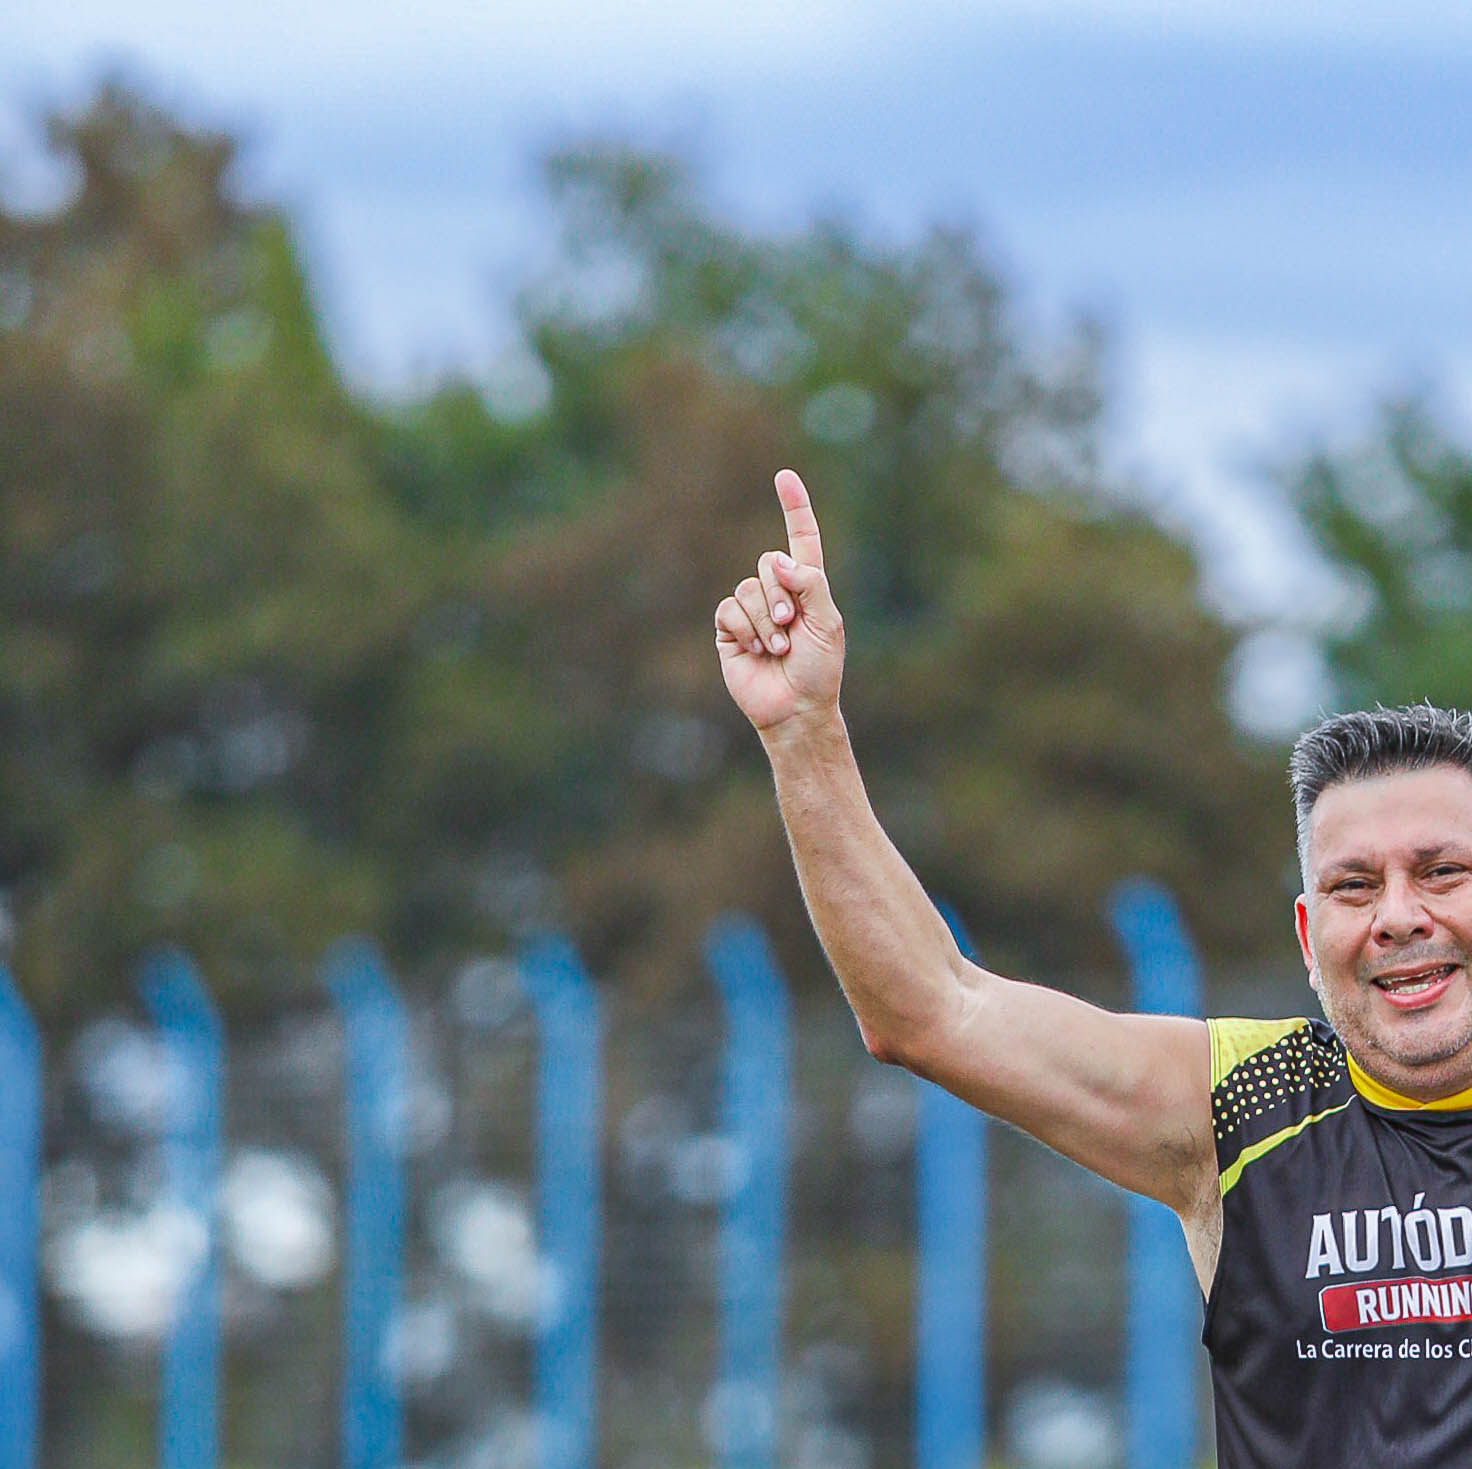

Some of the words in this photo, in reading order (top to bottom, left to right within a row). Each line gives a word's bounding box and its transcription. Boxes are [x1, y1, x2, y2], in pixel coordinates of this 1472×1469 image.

[1296, 1339, 1317, 1360] La
[1321, 1338, 1393, 1359] Carrera
[1398, 1336, 1420, 1358] de
[1425, 1337, 1453, 1358] los
